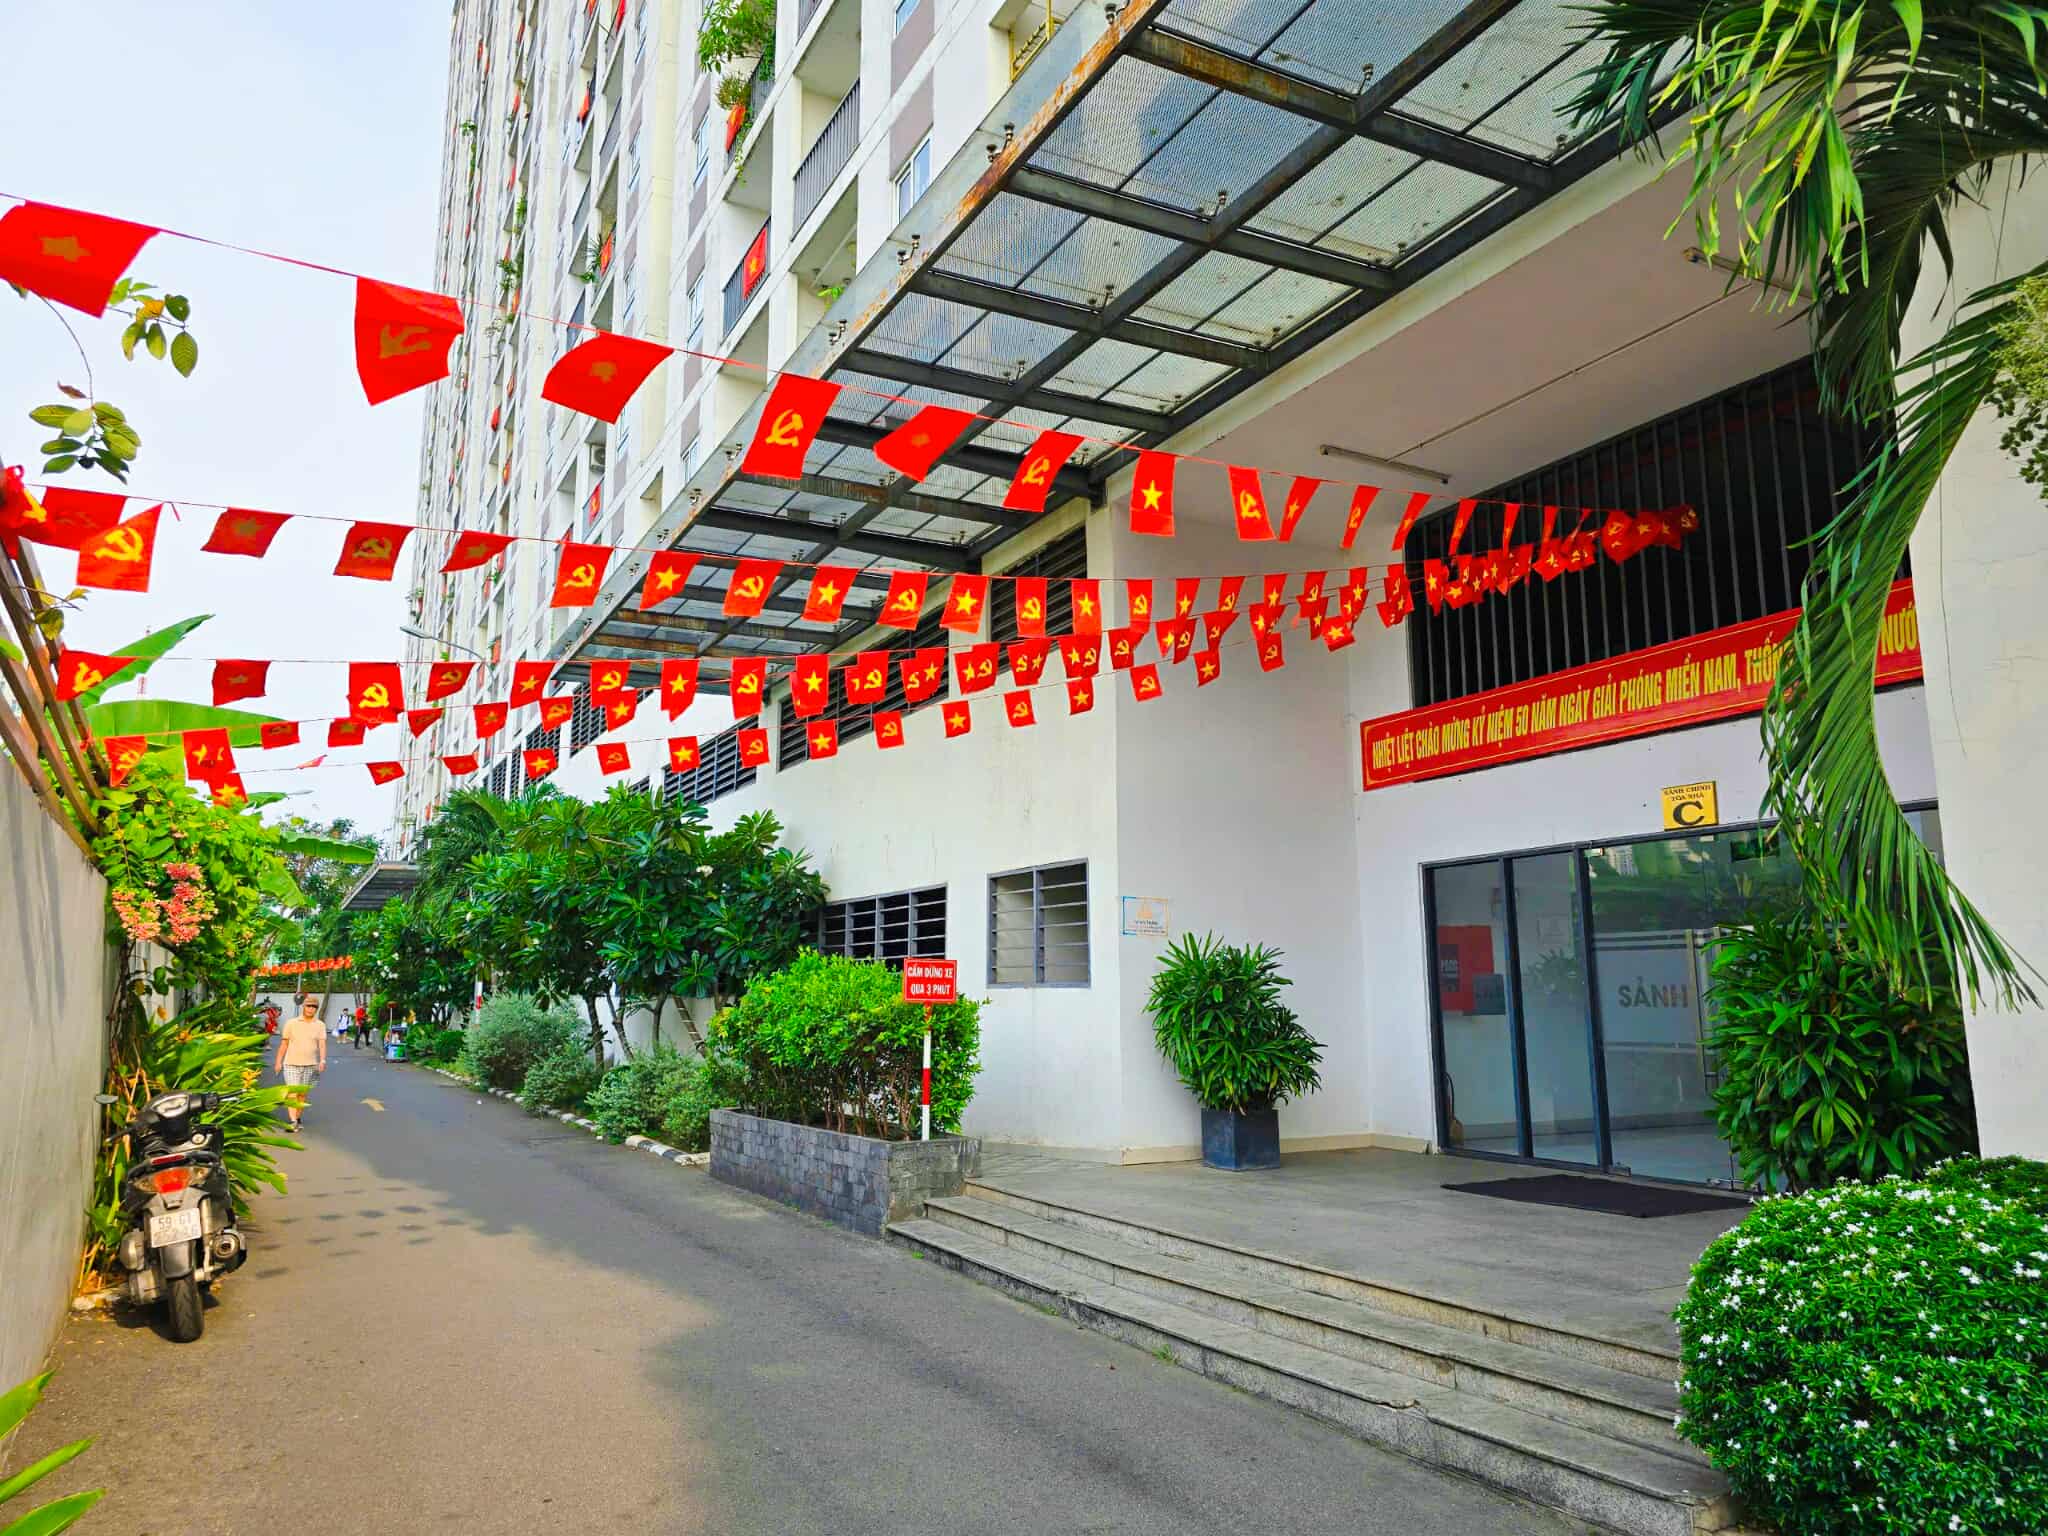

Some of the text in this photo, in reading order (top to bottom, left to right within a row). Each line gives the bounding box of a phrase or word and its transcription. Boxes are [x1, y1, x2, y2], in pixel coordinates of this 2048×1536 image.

[1372, 731, 1396, 773] NHIỆT
[1397, 727, 1415, 768] LIỆT
[1415, 721, 1440, 761] CHÀO
[1441, 715, 1471, 754] MỪNG
[1487, 703, 1514, 748] NIỆM
[1516, 704, 1529, 737] 50
[1530, 693, 1557, 734] NĂM
[1558, 684, 1591, 727] NGÀY
[1592, 672, 1617, 719] GIẢI
[1619, 668, 1663, 713] PHÓNG
[1665, 652, 1701, 704] MIỀN
[1703, 652, 1742, 696] NAM,
[1880, 601, 1920, 656] NƯỚ
[1673, 800, 1705, 826] C
[944, 967, 953, 978] XE
[926, 983, 931, 996] 3
